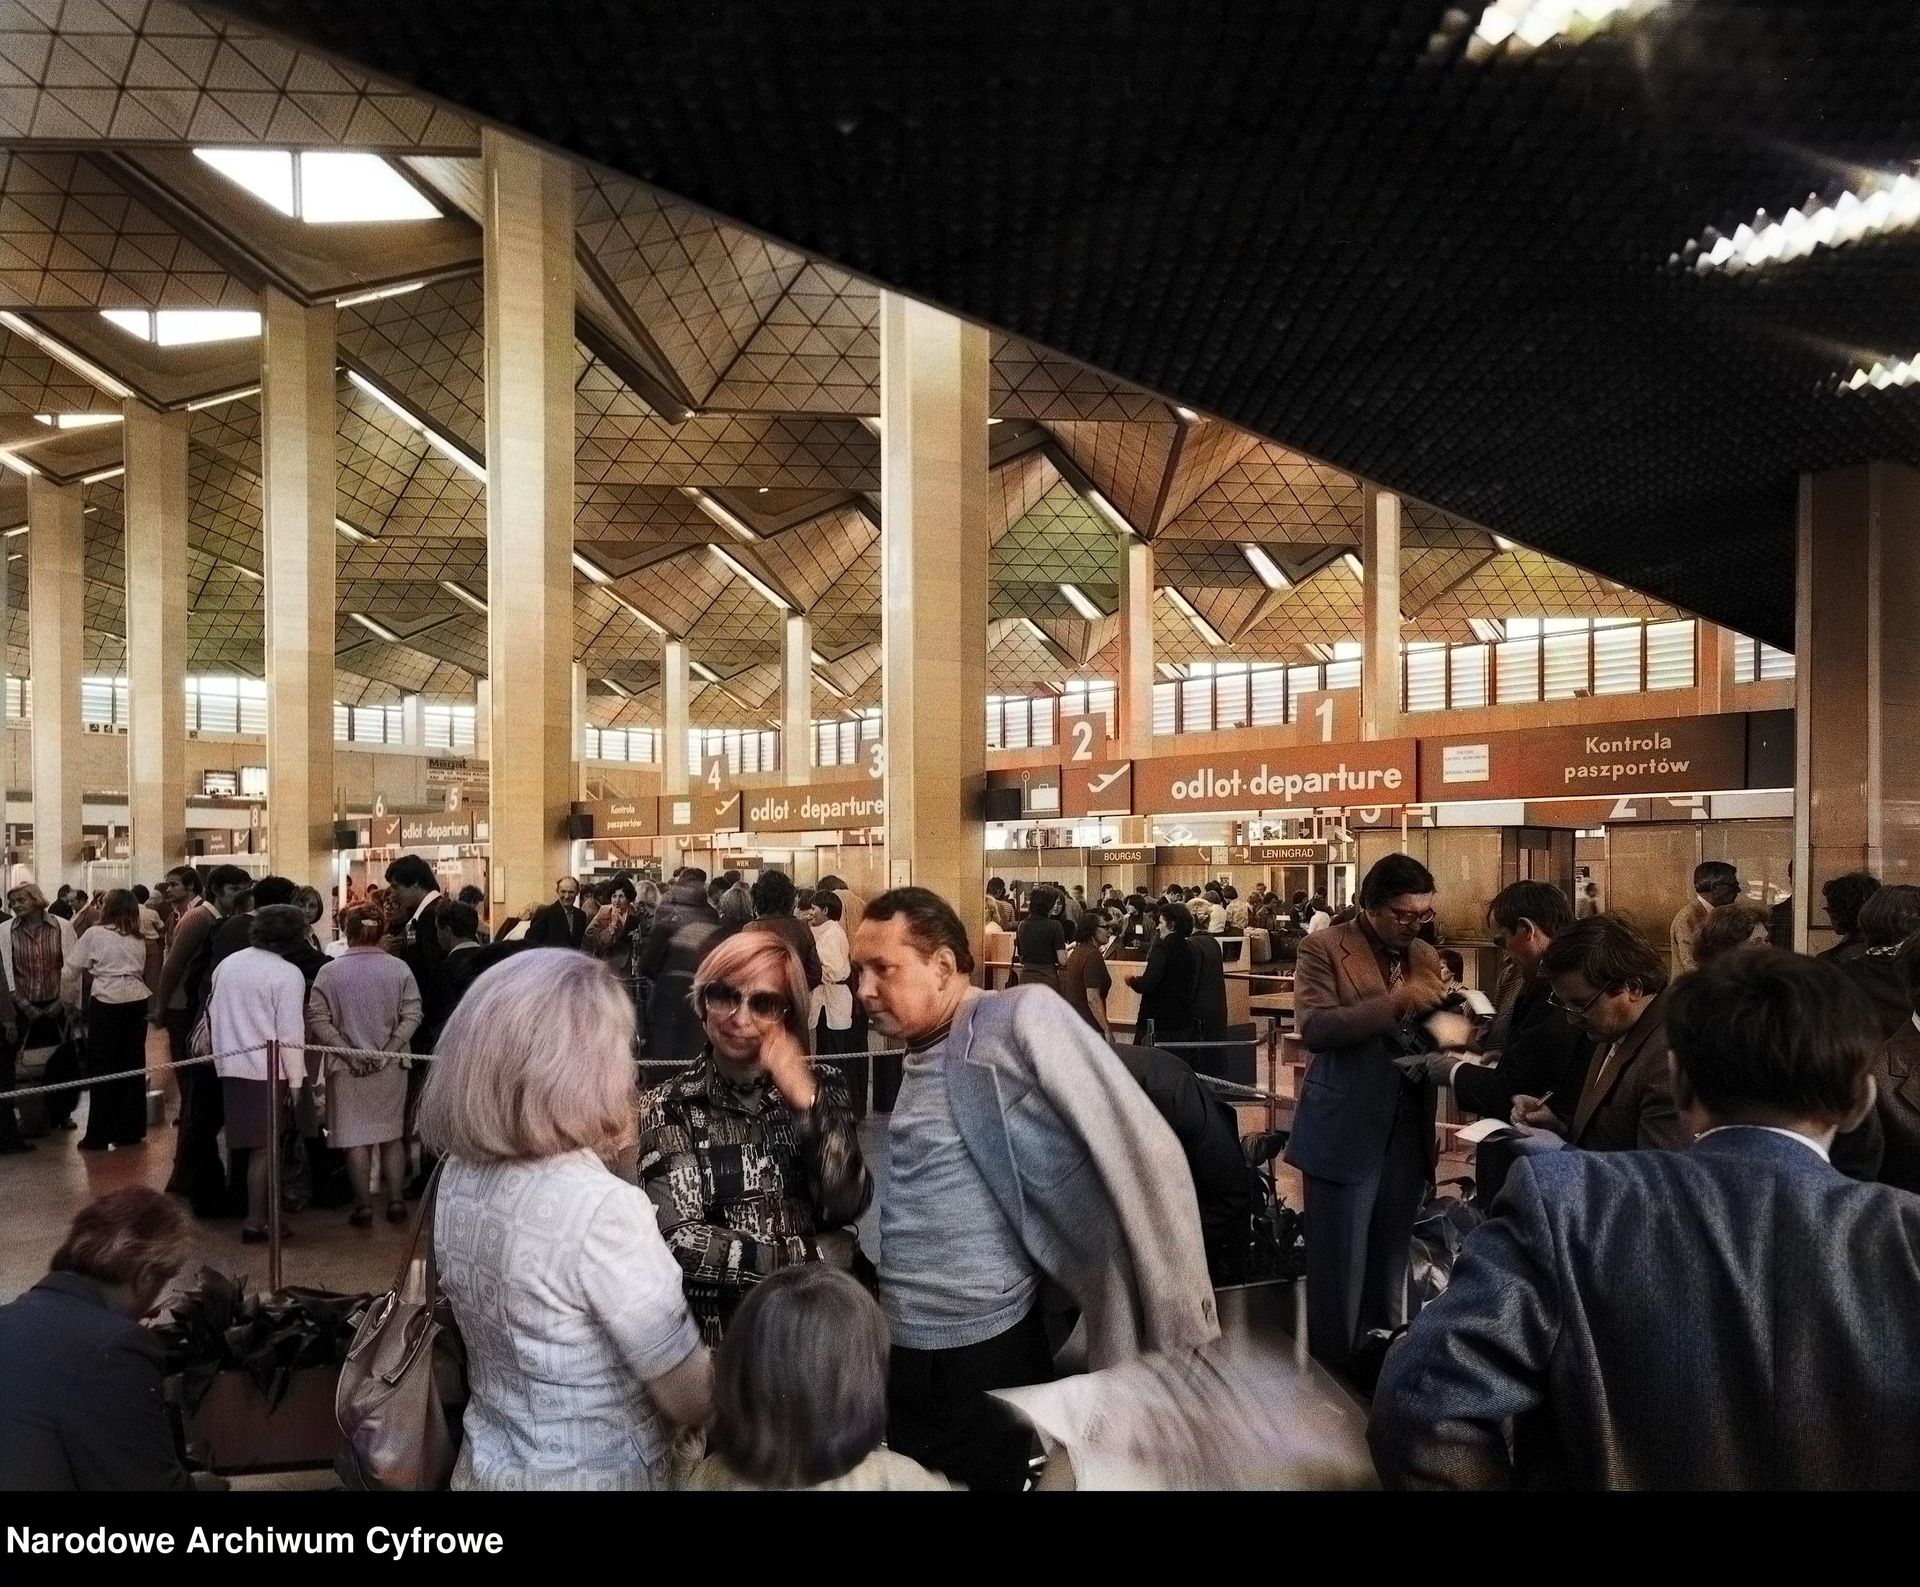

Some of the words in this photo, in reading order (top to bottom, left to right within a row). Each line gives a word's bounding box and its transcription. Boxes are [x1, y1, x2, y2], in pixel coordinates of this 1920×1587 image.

[1315, 698, 1333, 743] 1
[1071, 721, 1093, 761] 2
[1585, 732, 1672, 754] Kontrola
[869, 743, 884, 778] 3
[1564, 757, 1690, 784] paszportów
[707, 760, 721, 790] 4
[375, 795, 384, 818] 6
[449, 787, 459, 811] 5
[610, 804, 635, 815] Kontrola
[252, 807, 259, 827] 8
[427, 821, 469, 842] departure
[1103, 851, 1142, 861] BOURGAS
[1261, 848, 1314, 859] LENINGRAD
